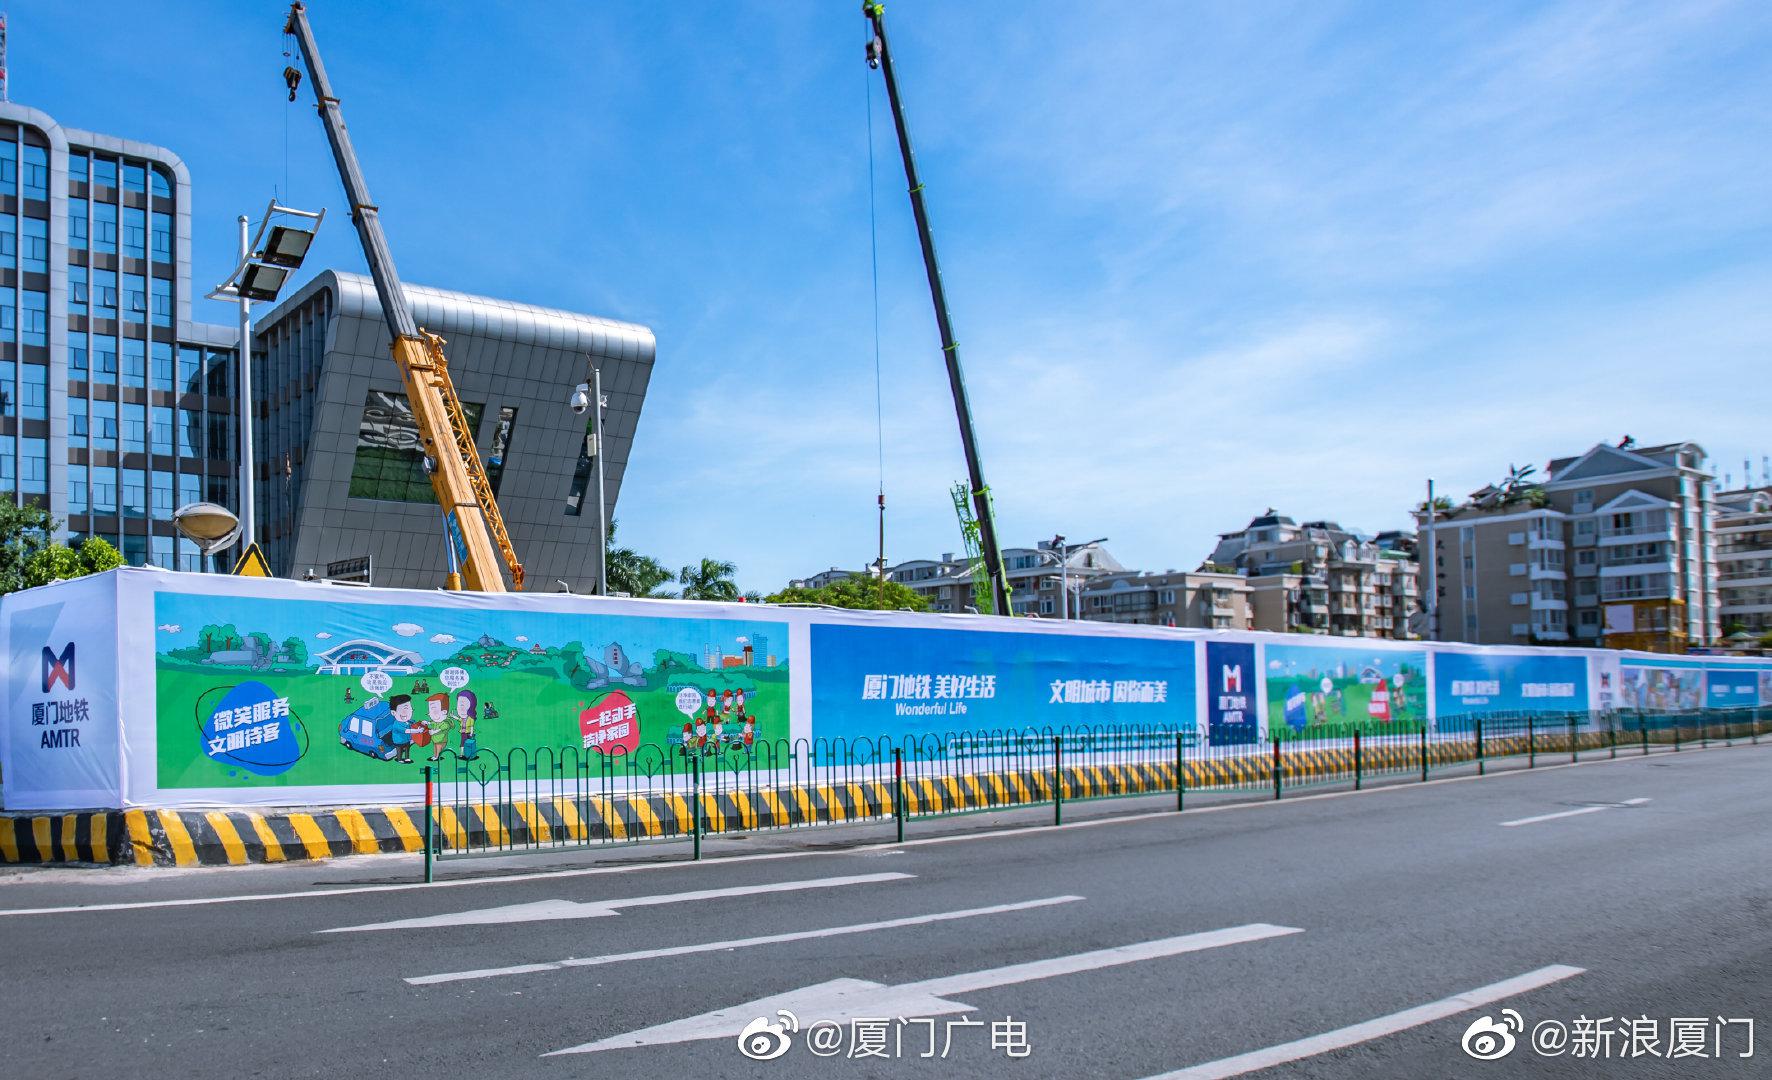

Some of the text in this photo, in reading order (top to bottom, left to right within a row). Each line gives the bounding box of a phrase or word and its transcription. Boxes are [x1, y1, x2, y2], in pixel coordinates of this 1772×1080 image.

[862, 674, 996, 700] 厦门地铁 美好生活
[1049, 679, 1112, 703] 文明城市
[31, 698, 90, 726] 厦门地铁
[213, 697, 290, 732] 微笑服务
[586, 703, 637, 728] 一起动手
[895, 701, 967, 716] Wonderful Life
[41, 728, 81, 749] AMTR
[208, 722, 280, 756] 文明待客
[583, 722, 630, 749] 洁净家园
